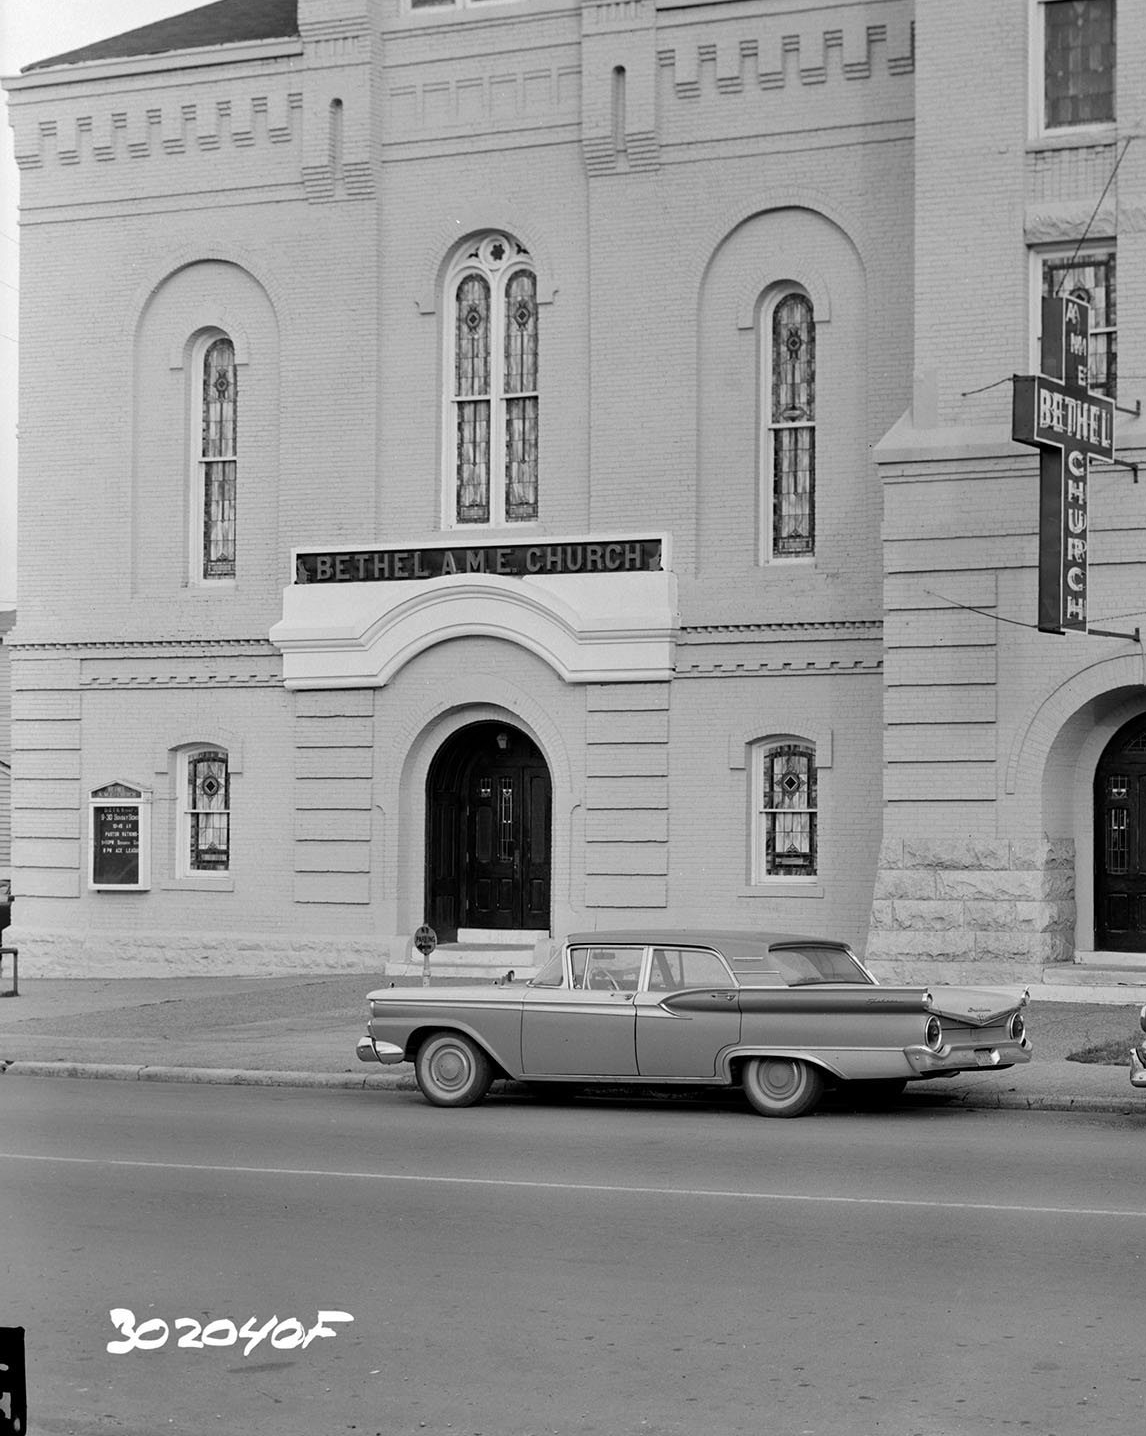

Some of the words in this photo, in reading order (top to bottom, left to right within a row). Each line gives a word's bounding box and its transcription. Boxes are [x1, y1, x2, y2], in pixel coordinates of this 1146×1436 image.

[1040, 388, 1111, 448] BETHEL
[316, 551, 429, 580] BETHEL
[526, 543, 641, 573] CHURCH
[1066, 450, 1087, 621] CHURCH
